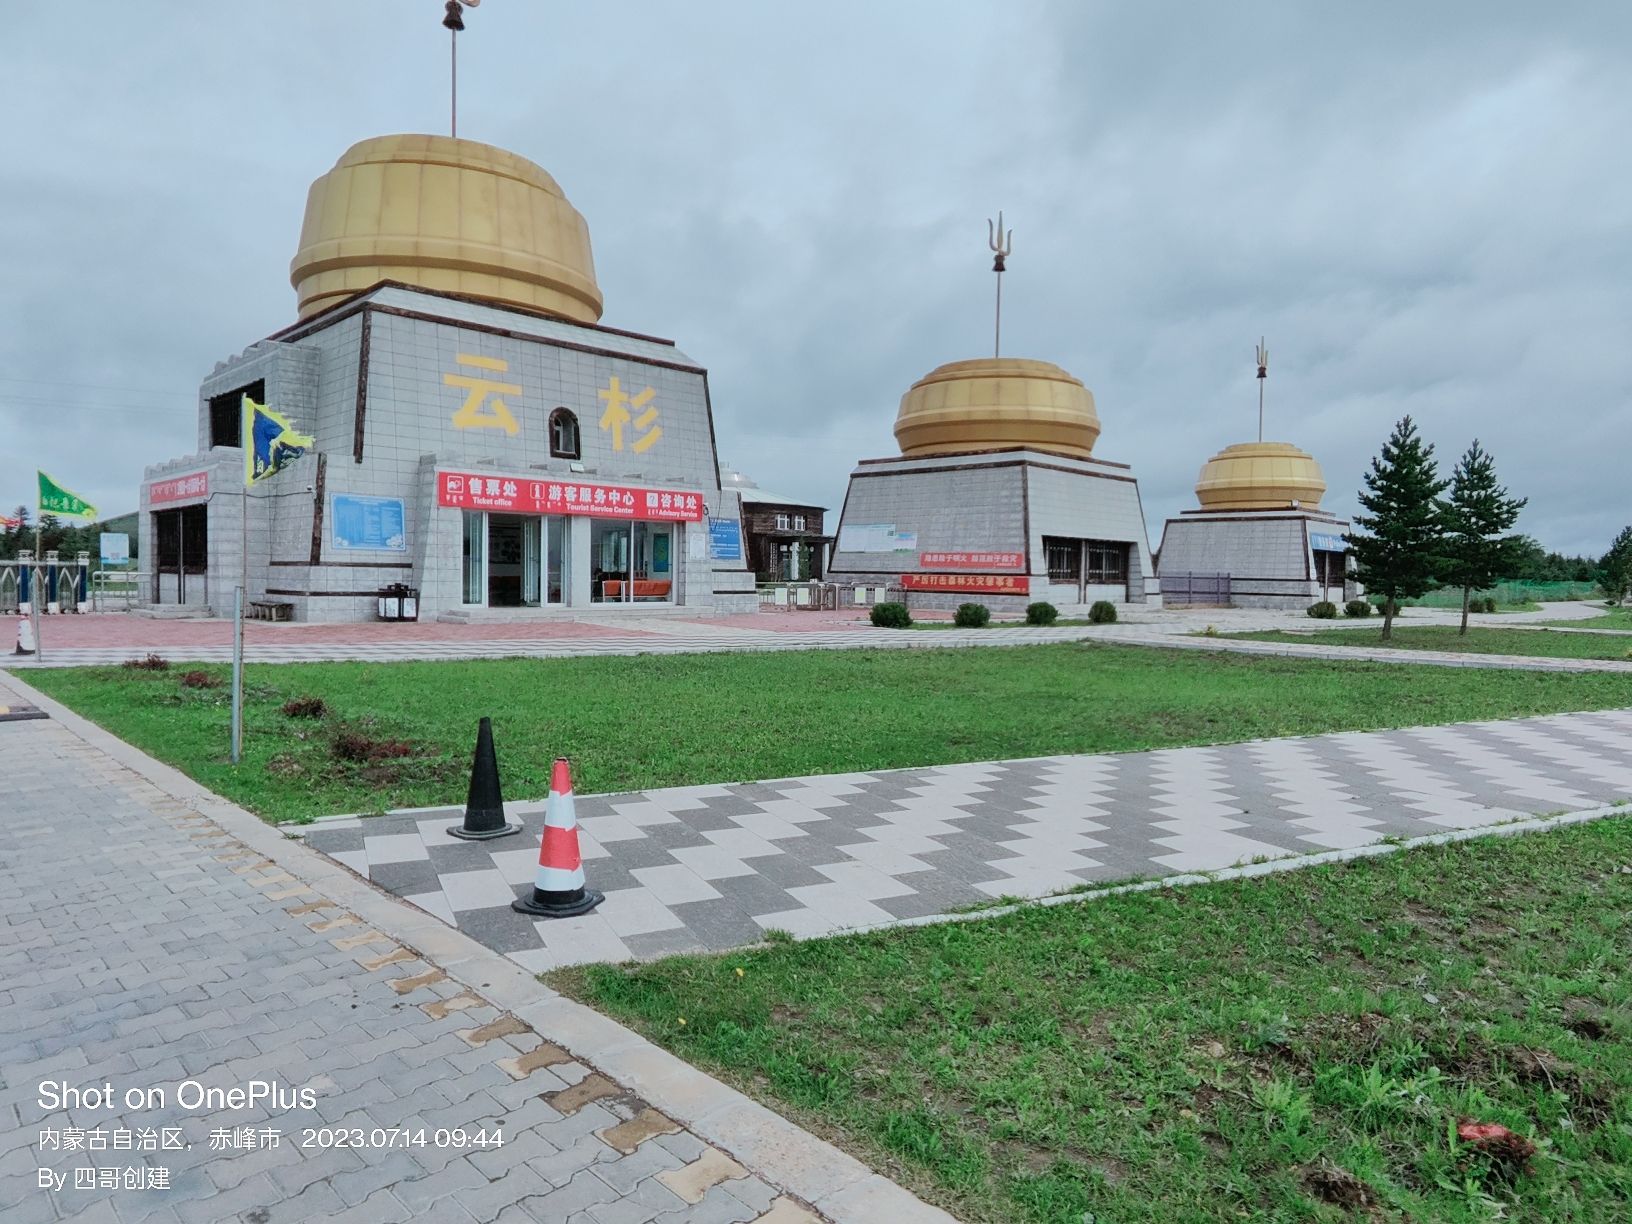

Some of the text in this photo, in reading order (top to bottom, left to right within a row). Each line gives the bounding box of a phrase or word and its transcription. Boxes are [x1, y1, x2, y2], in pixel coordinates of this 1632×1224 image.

[443, 353, 664, 454] 云杉
[469, 478, 518, 498] 售票处
[548, 485, 635, 506] 游客服务中心
[472, 496, 493, 505] Ticket
[494, 497, 513, 506] office
[566, 503, 590, 512] Tourist
[590, 505, 613, 513] Service
[613, 506, 635, 514] Center
[660, 494, 698, 509] 咨询处
